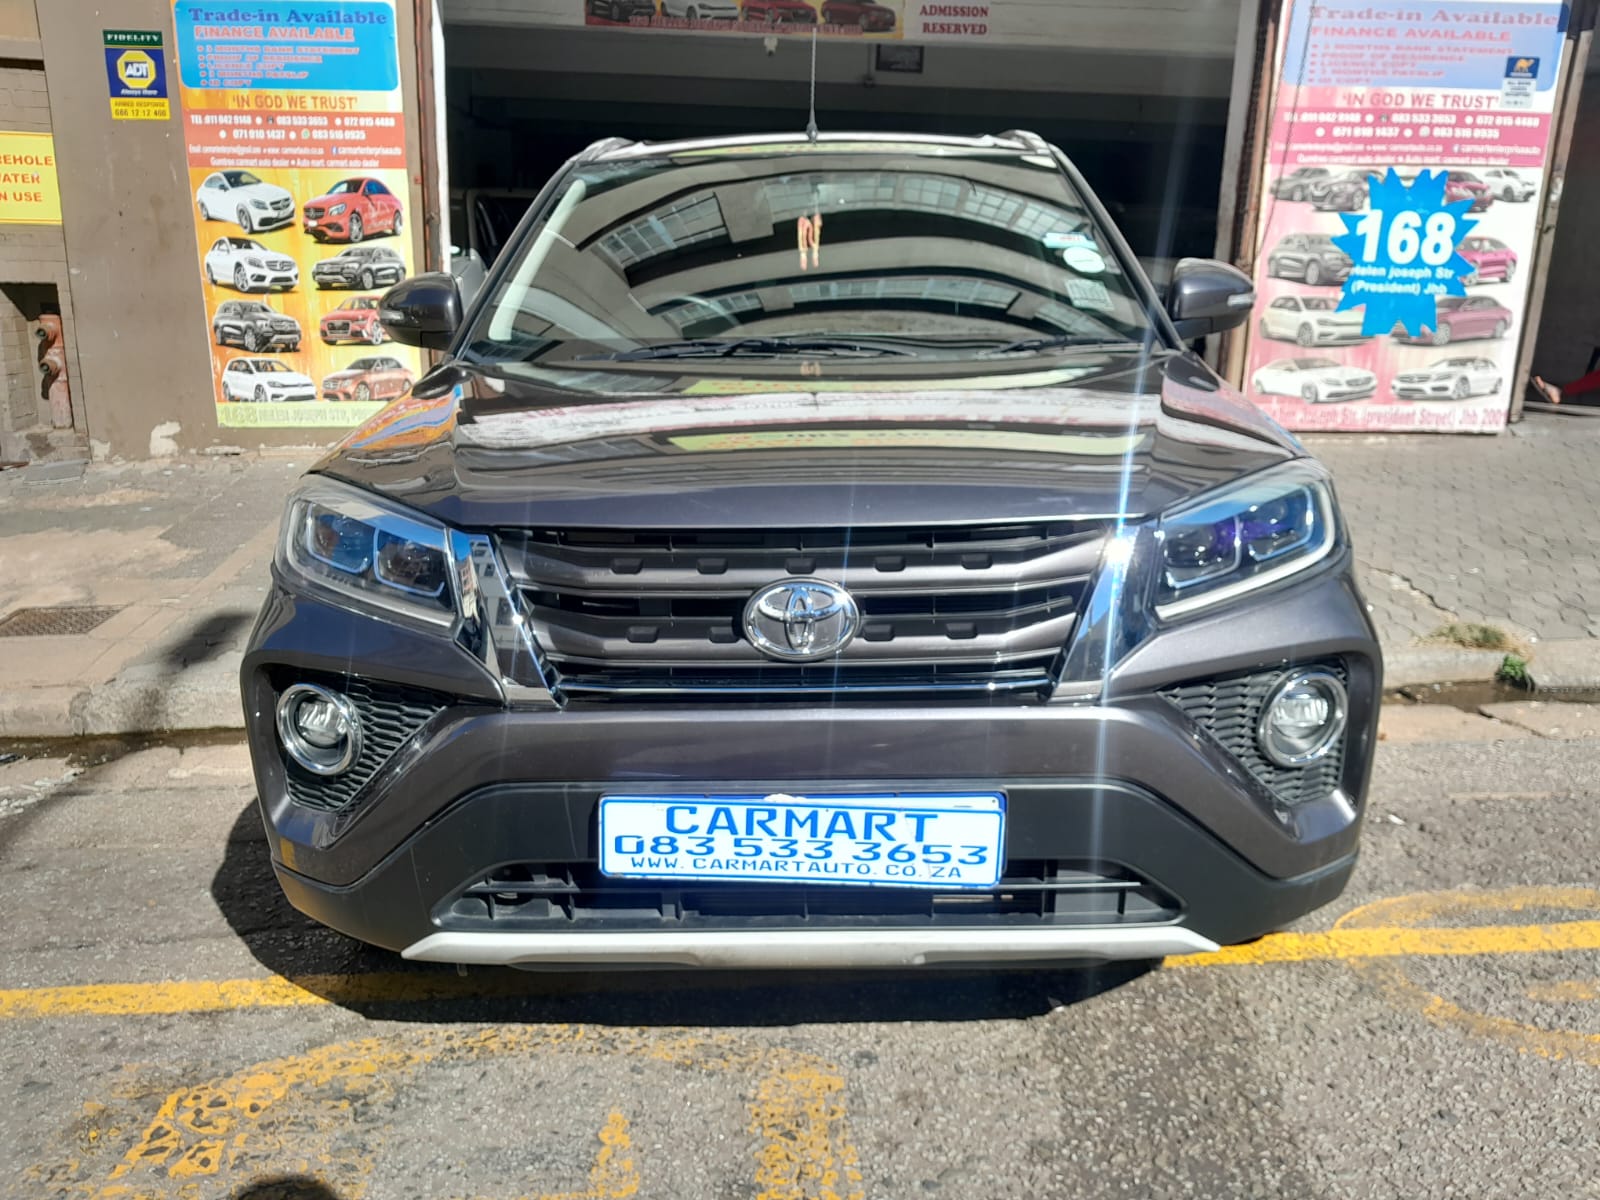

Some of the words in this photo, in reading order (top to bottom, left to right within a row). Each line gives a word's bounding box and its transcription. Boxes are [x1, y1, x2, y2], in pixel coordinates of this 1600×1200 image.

[188, 8, 279, 22] Trade-in
[287, 9, 387, 24] Available
[920, 4, 989, 17] ADMISSION
[1309, 6, 1422, 21] Trade-in
[1432, 9, 1558, 25] Available
[195, 26, 263, 40] FINANCE
[268, 27, 355, 41] AVAILABLE
[923, 22, 987, 35] RESERVED
[1311, 26, 1396, 38] FINANCE
[1405, 28, 1511, 42] AVAILABLE
[106, 33, 160, 42] FIDELITY
[125, 62, 148, 77] ADT
[255, 95, 282, 109] GOD
[287, 96, 307, 109] WE
[1370, 93, 1405, 106] GOD
[1411, 94, 1435, 107] WE
[0, 155, 53, 166] EHOLE
[0, 173, 41, 184] ATER
[13, 192, 43, 202] USE
[1355, 209, 1456, 266] 168
[1434, 266, 1455, 279] Str
[1351, 279, 1421, 296] (President)
[666, 805, 939, 843] CARMART
[614, 834, 715, 857] 083
[733, 837, 834, 860] 533
[851, 841, 988, 866] 3653
